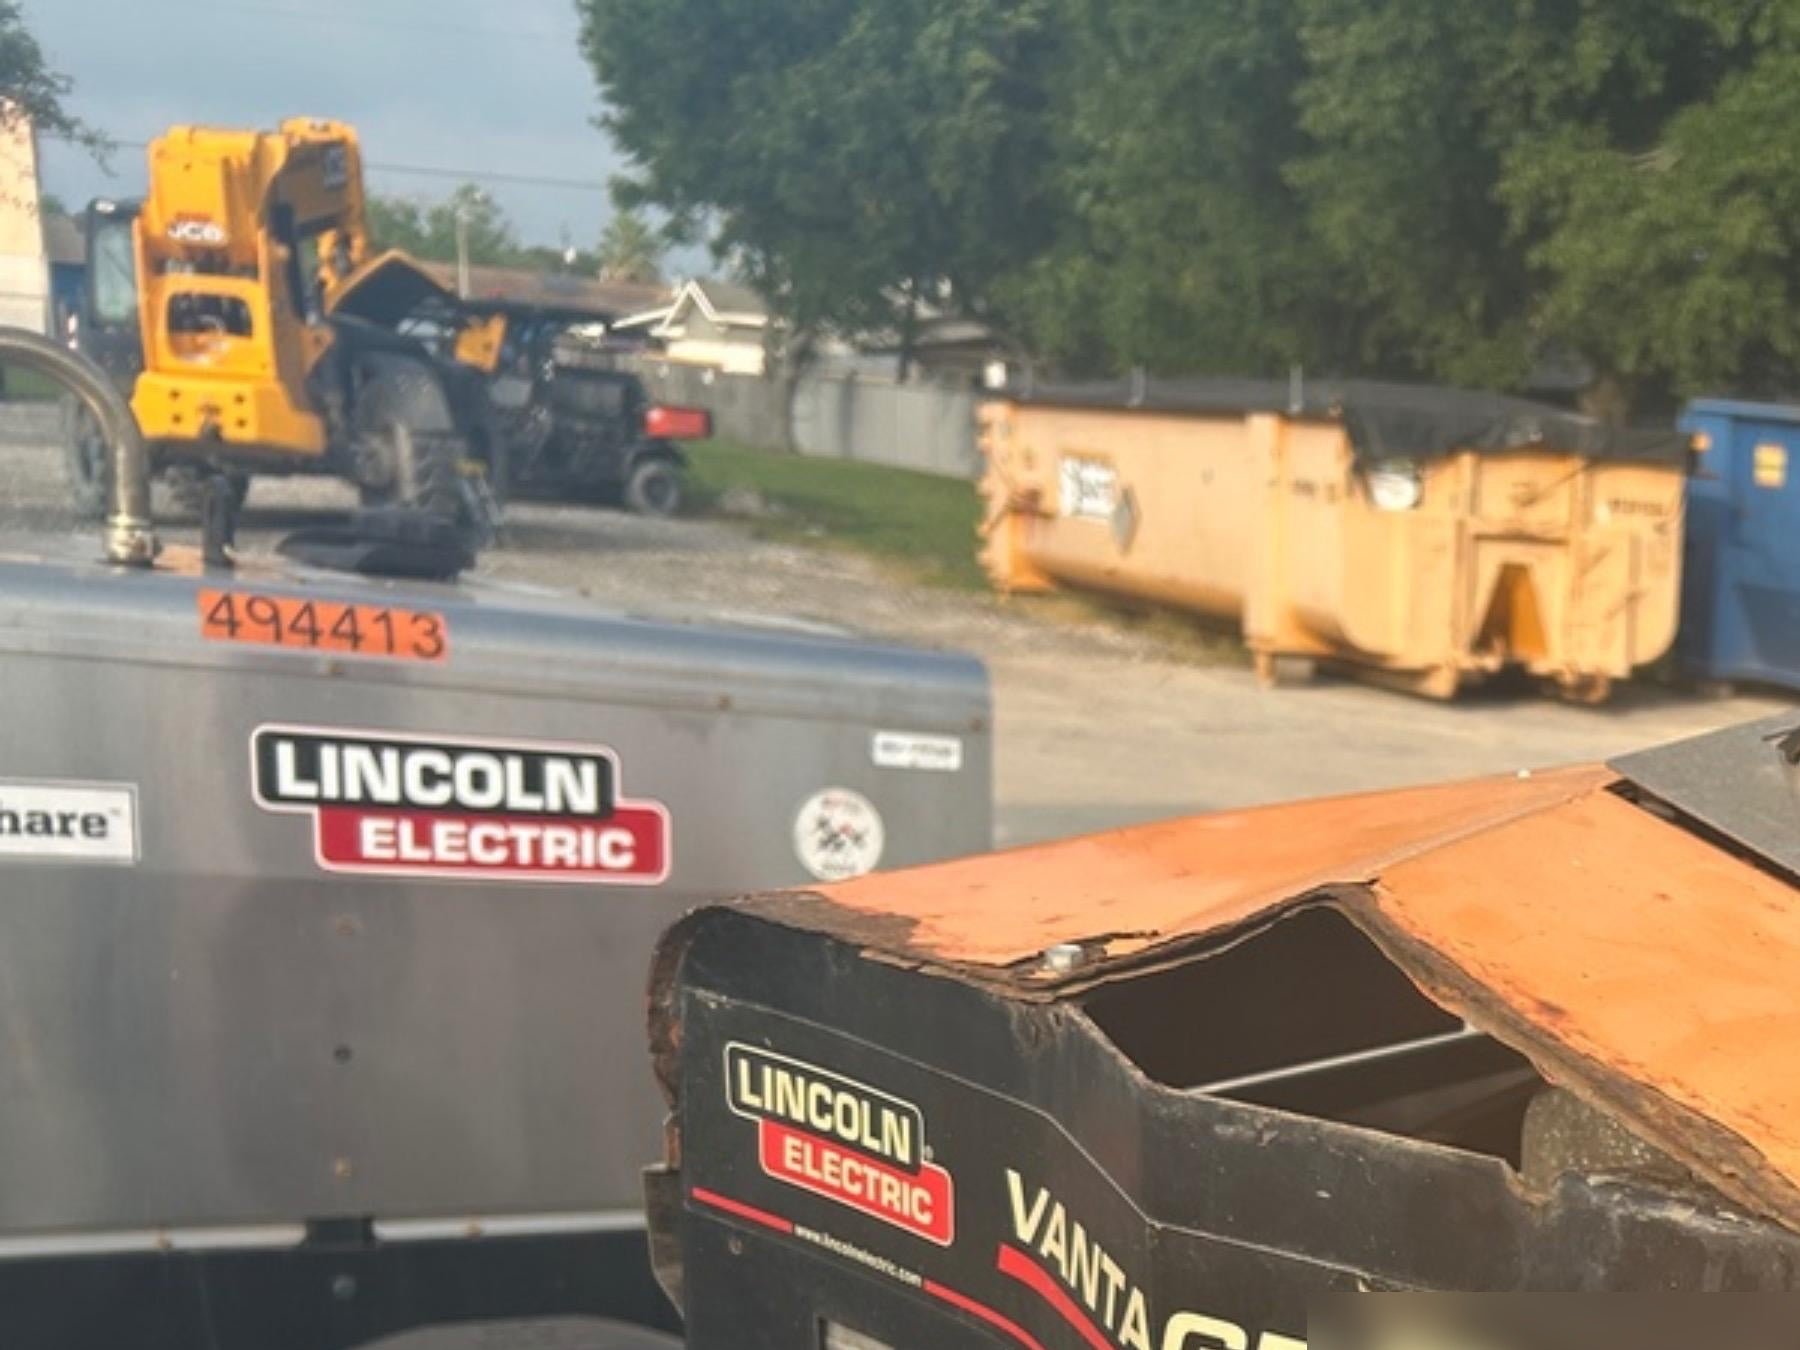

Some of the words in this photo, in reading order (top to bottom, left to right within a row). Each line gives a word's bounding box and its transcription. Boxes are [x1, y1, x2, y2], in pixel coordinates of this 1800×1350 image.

[206, 593, 445, 659] 494413
[274, 740, 599, 814] LINCOLN
[358, 815, 637, 869] ELECTRIC
[737, 1057, 912, 1165] LINCOLN
[782, 1135, 934, 1226] ELECTRIC
